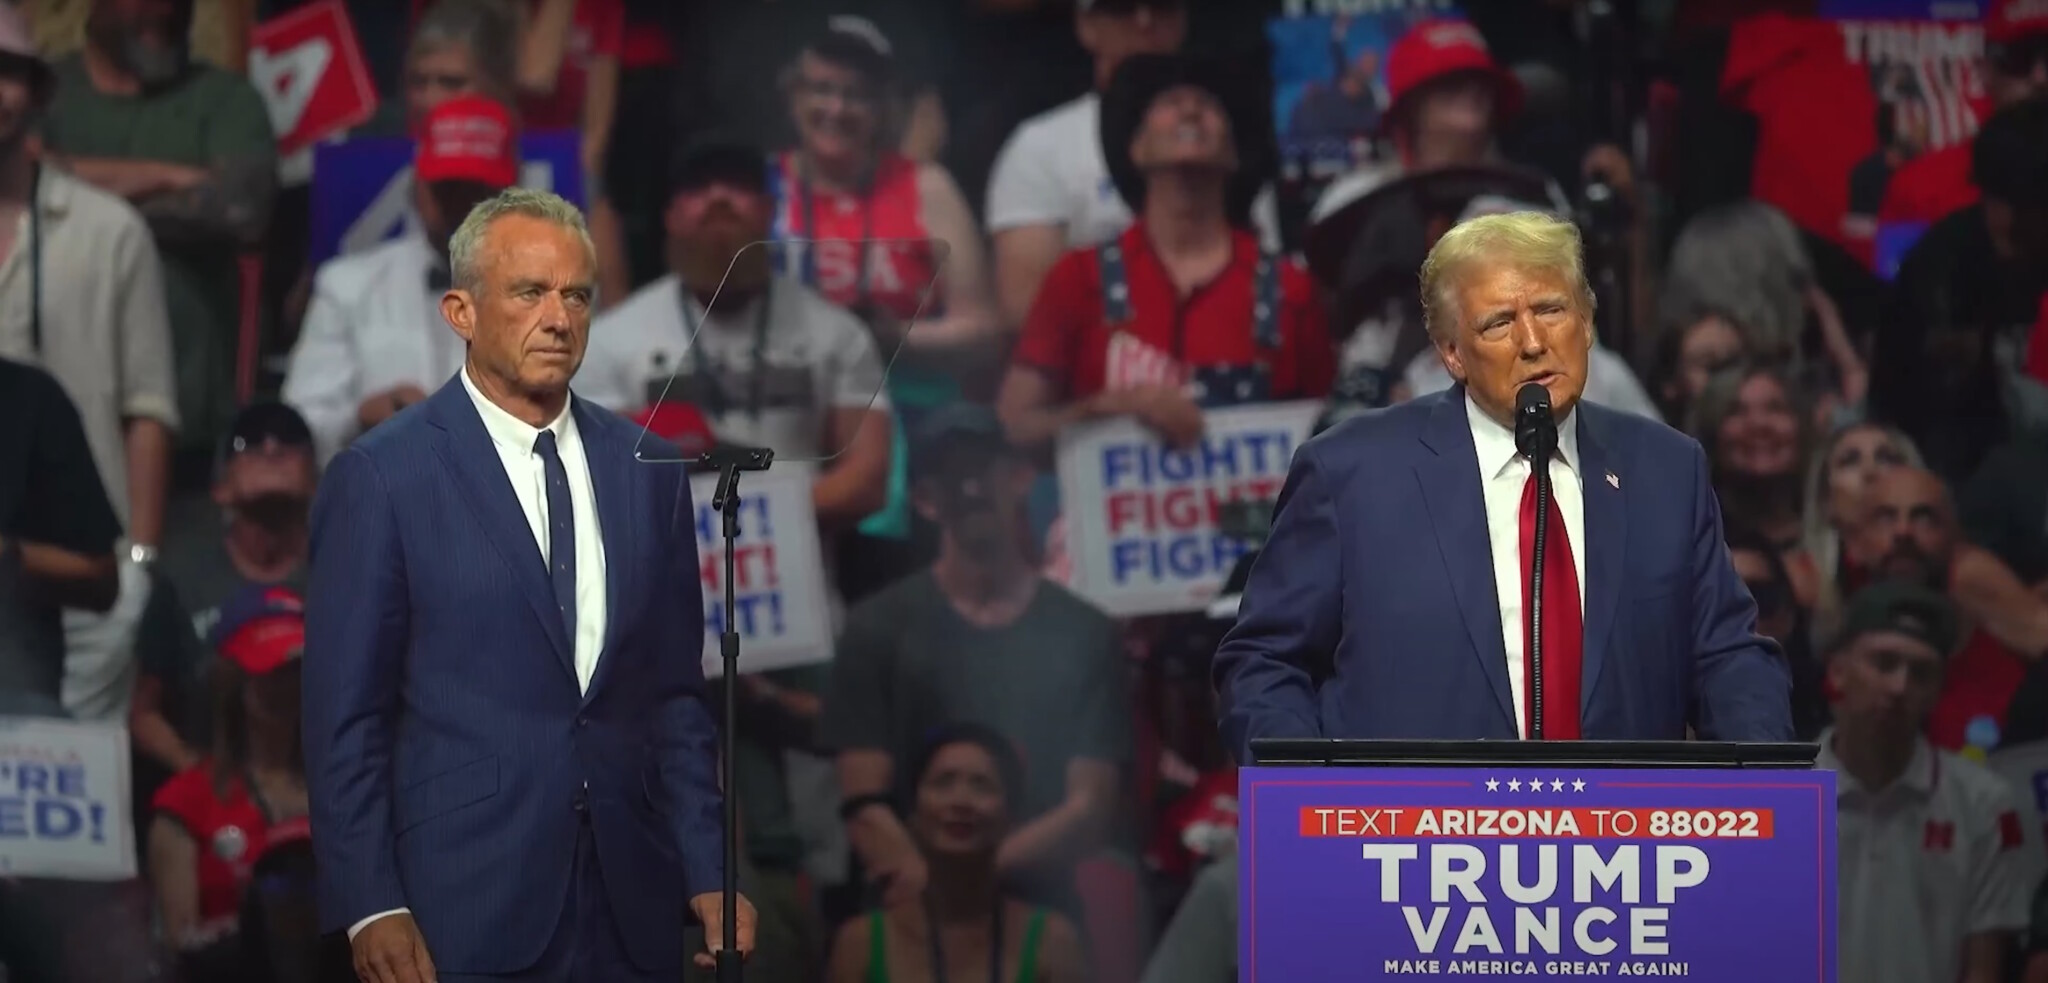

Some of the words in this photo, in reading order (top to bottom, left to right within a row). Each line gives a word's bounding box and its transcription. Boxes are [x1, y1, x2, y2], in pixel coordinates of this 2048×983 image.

[1101, 430, 1294, 487] FIGHT!
[1112, 534, 1250, 585] FIGH
[1314, 809, 1404, 836] TEXT
[1414, 809, 1580, 837] ARIZONA
[1590, 810, 1638, 837] TO
[1649, 810, 1760, 838] 88022
[1362, 843, 1711, 904] TRUMP
[1401, 906, 1671, 956] VANCE
[1384, 960, 1441, 974] MAKE
[1447, 960, 1538, 975] AMERICA
[1545, 961, 1611, 976] GREAT
[1617, 962, 1690, 977] AGAIN!
